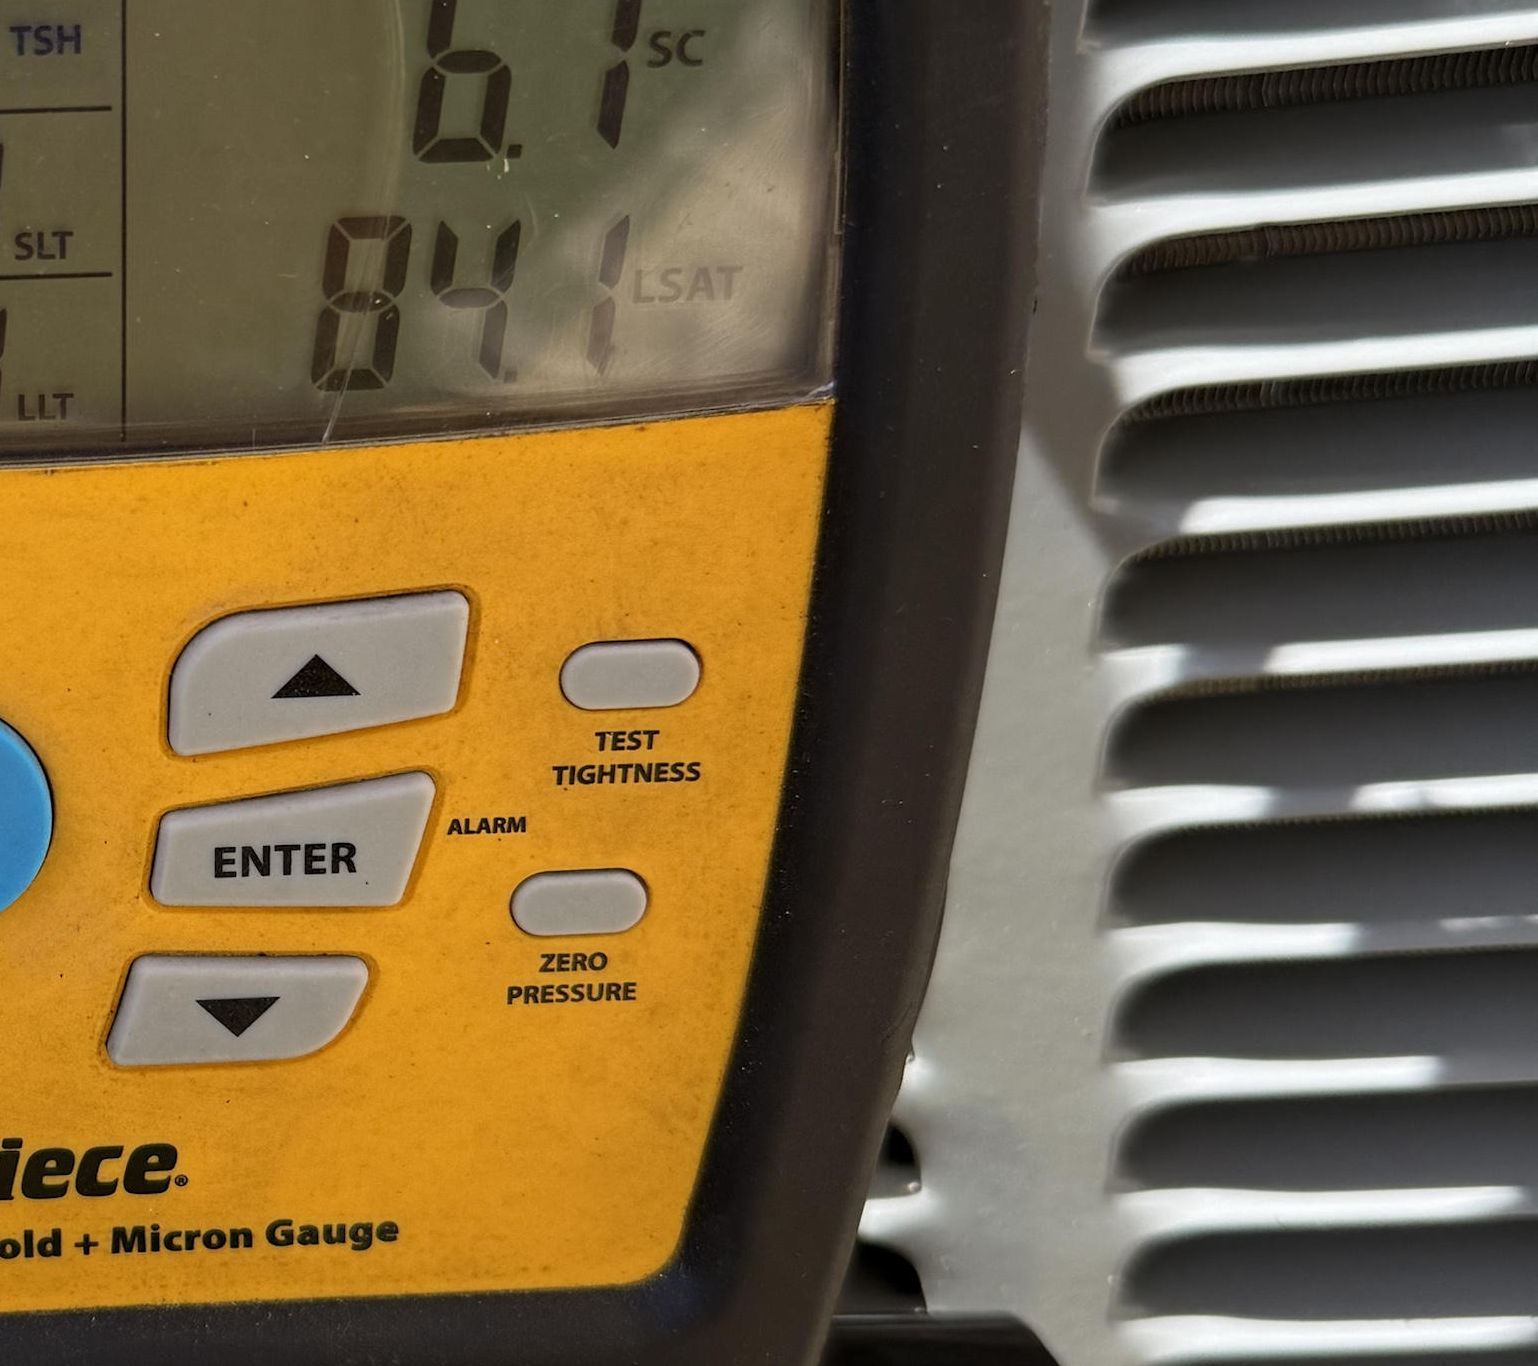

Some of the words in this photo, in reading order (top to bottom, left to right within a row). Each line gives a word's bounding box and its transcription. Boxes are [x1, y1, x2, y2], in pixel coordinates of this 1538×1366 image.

[9, 24, 82, 55] TSH
[646, 30, 705, 67] SC
[14, 231, 73, 261] SLT
[311, 215, 631, 392] 84.1
[631, 265, 743, 305] LSAT
[17, 392, 75, 421] LLT
[595, 730, 660, 752] TEST
[552, 761, 701, 785] TIGHTNESS
[447, 816, 527, 836] ALARM
[214, 841, 357, 879] ENTER
[539, 951, 608, 974] ZERO
[507, 981, 637, 1005] PRESSURE
[74, 1233, 100, 1256] +
[110, 1223, 254, 1254] Micron
[265, 1218, 400, 1251] Gauge
